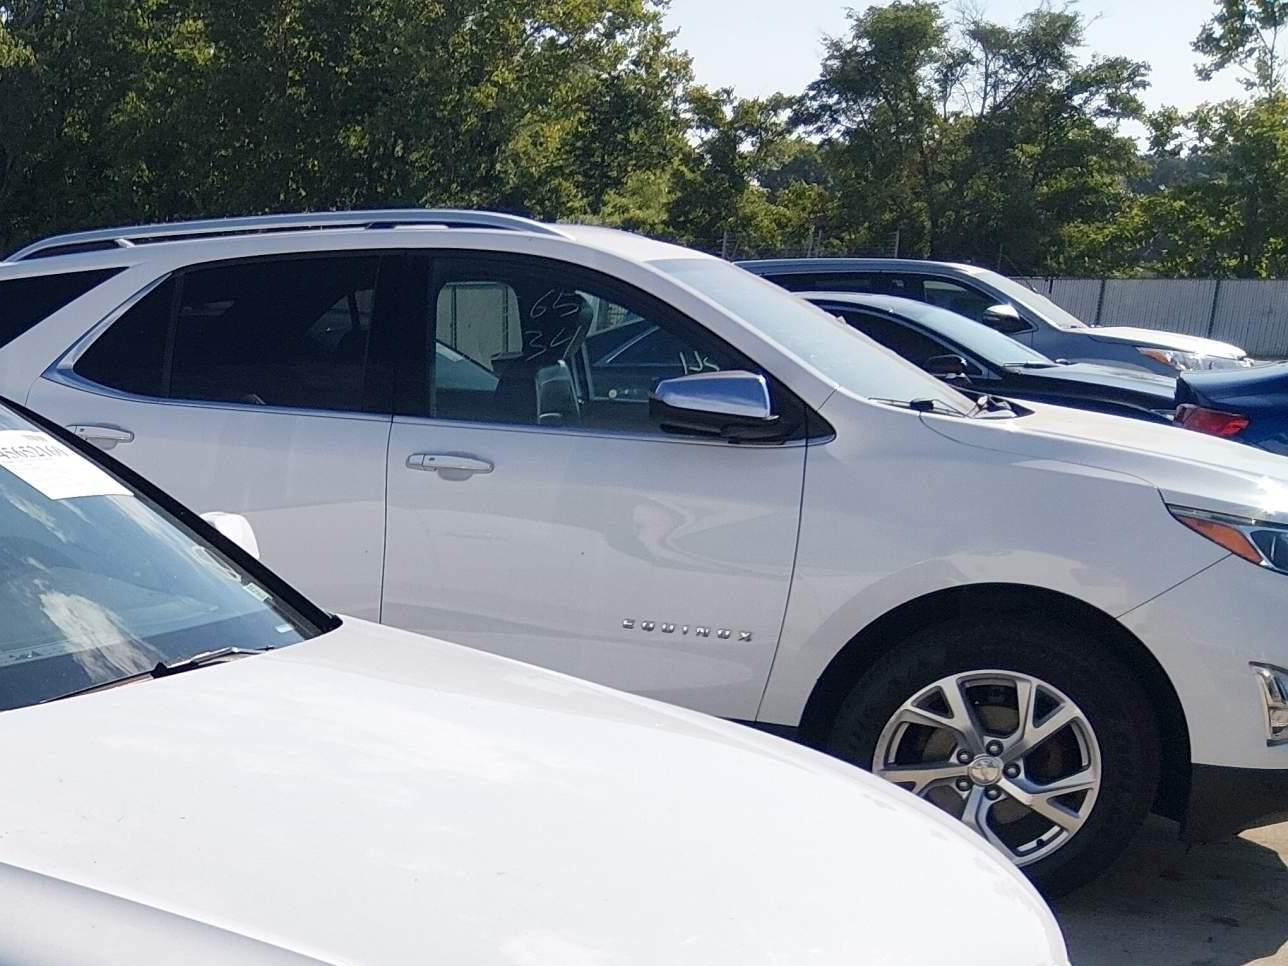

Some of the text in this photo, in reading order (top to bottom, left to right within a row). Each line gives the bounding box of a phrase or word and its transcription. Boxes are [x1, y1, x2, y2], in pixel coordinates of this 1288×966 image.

[529, 288, 580, 319] 65
[525, 325, 583, 361] 34
[622, 618, 753, 642] EQUINOX
